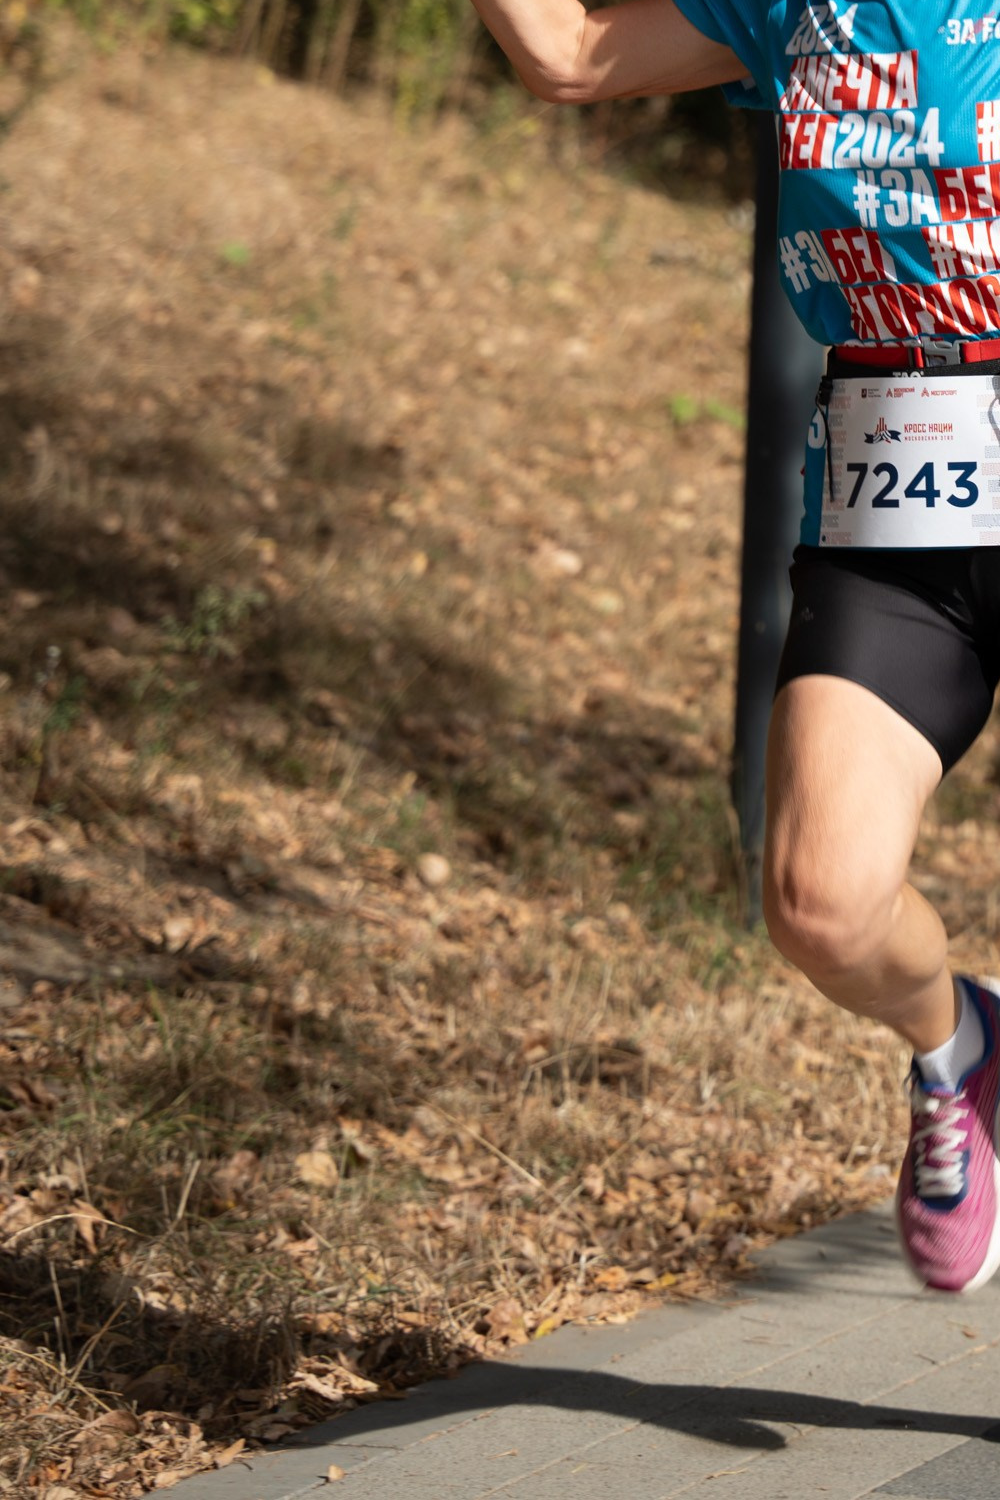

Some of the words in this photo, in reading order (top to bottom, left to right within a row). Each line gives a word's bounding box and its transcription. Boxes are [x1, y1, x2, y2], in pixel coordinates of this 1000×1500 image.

[775, 108, 945, 169] БЕГ2024
[903, 423, 927, 434] КРОСС
[928, 422, 953, 434] НАЦИИ
[846, 461, 979, 509] 7243
